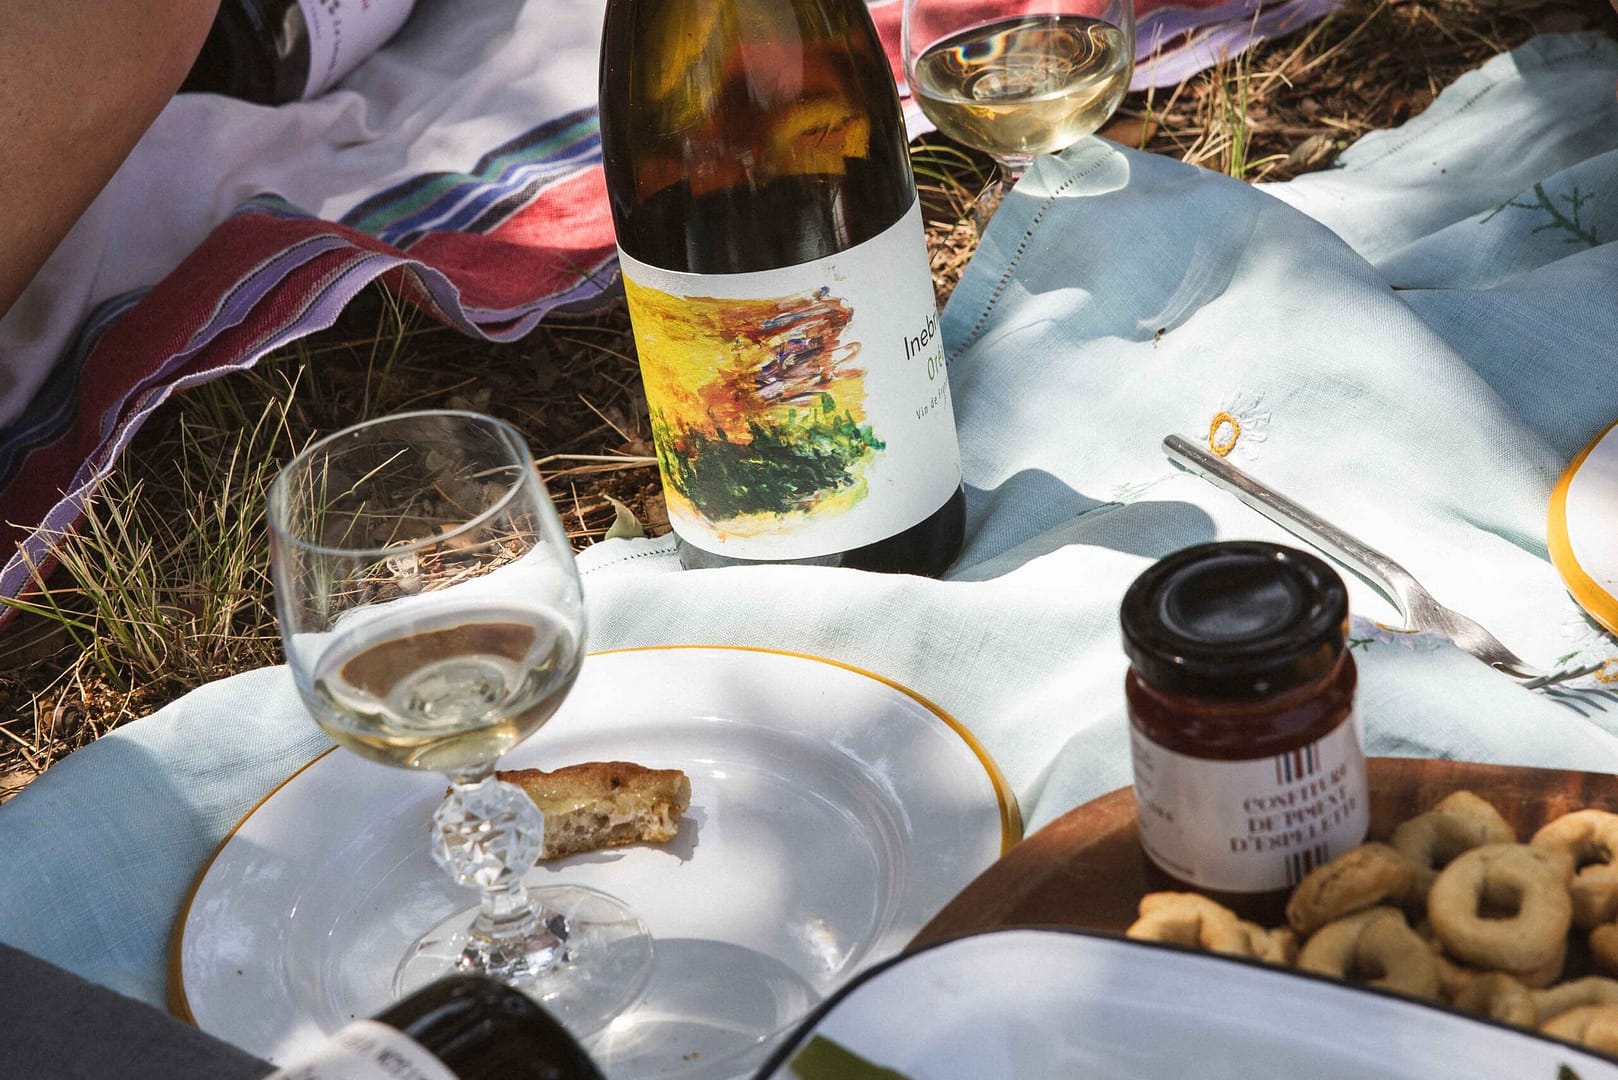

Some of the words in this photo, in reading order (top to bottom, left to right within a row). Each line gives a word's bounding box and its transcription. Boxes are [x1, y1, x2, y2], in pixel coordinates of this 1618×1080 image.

[915, 405, 929, 420] Vin
[930, 396, 938, 409] de
[1248, 816, 1272, 833] DE
